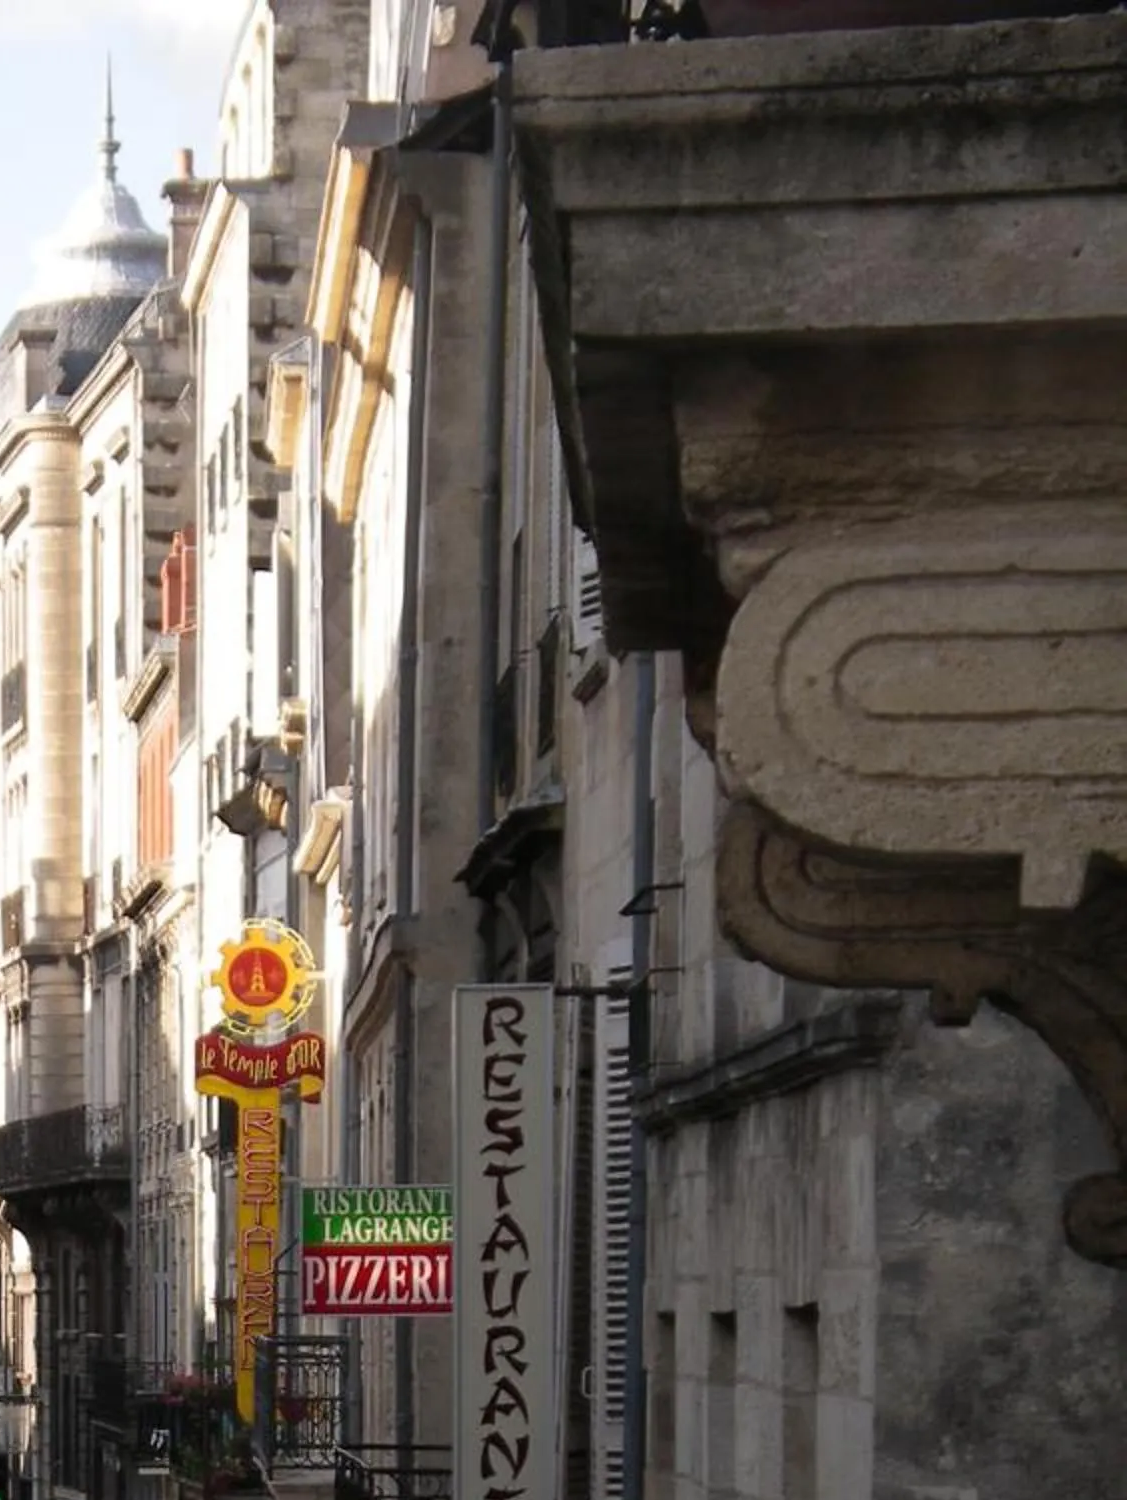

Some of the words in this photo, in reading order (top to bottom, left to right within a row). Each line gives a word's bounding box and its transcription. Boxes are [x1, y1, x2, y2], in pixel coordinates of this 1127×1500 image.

[218, 1035, 279, 1085] Temple
[313, 1188, 453, 1215] RISTORANT
[323, 1216, 454, 1243] LAGRANGE
[304, 1254, 454, 1306] PIZZERI
